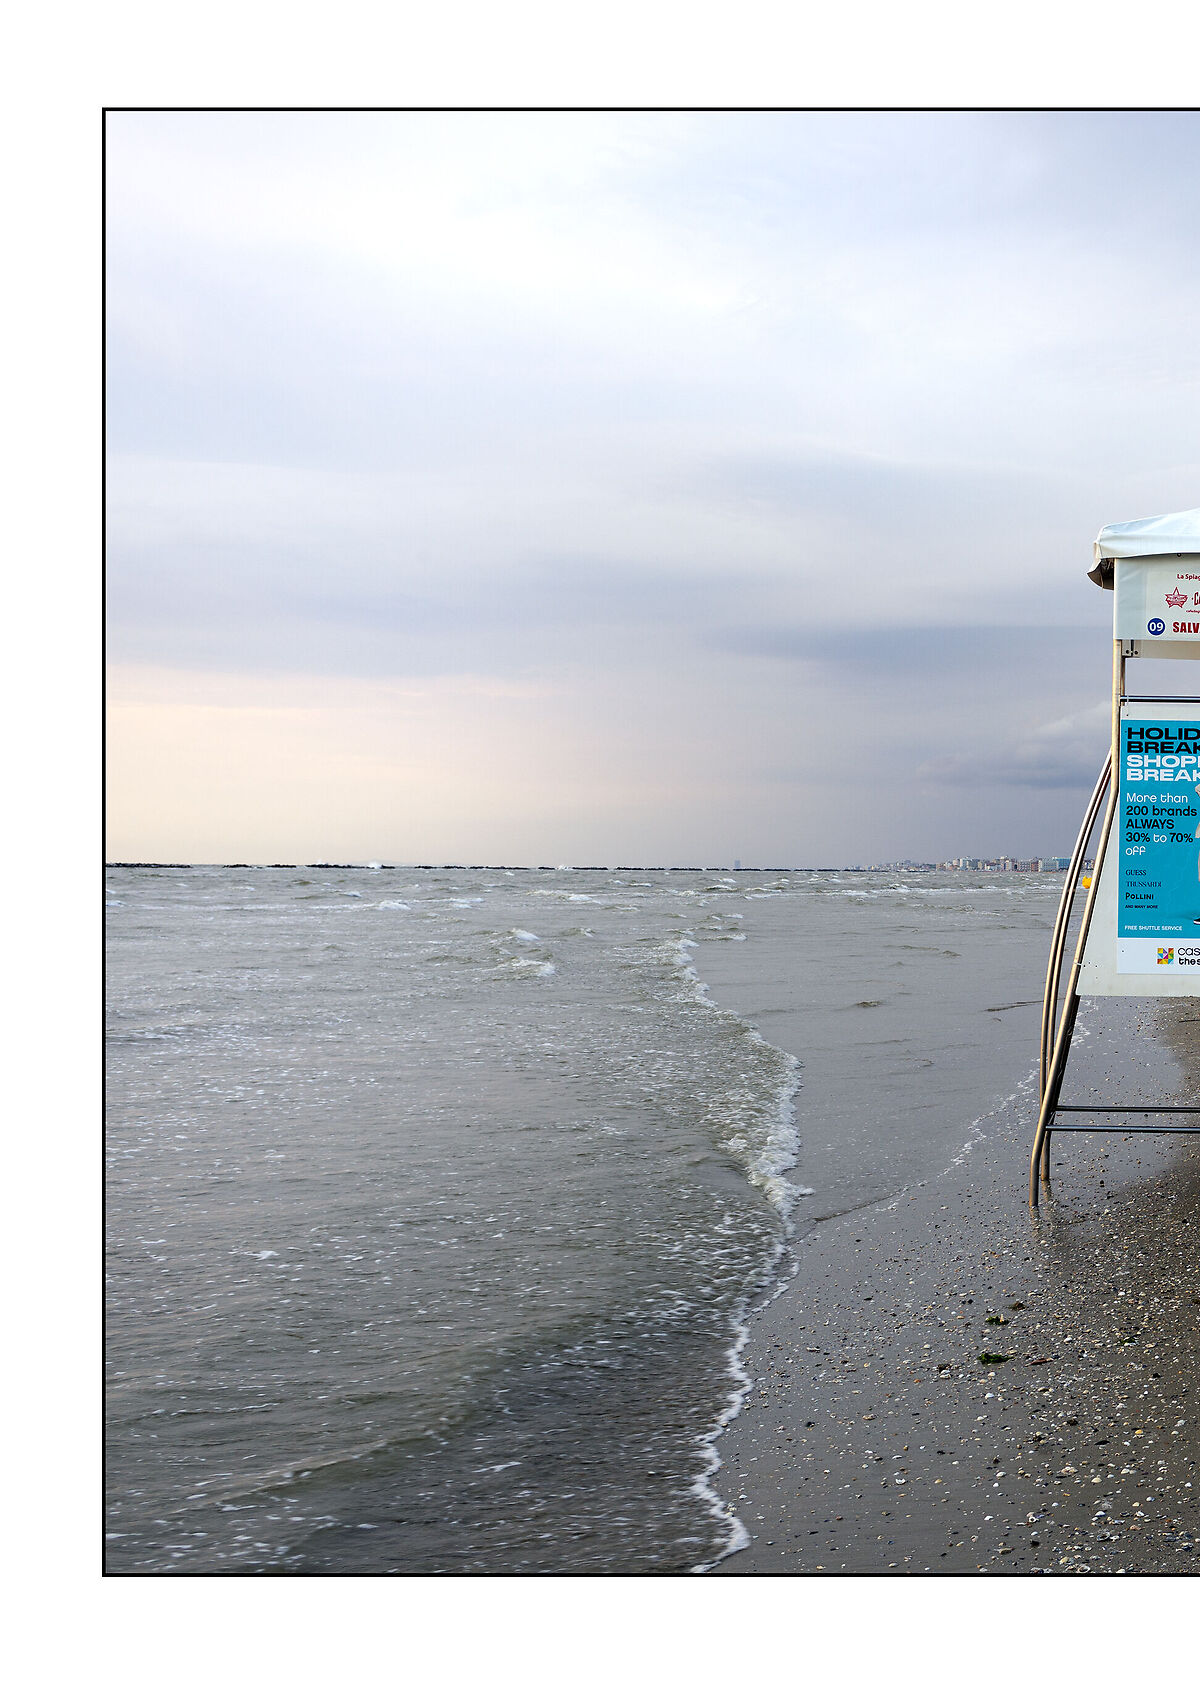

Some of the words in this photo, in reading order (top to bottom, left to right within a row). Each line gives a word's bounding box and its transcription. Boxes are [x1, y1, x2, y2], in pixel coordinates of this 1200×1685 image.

[1149, 622, 1164, 631] 09
[1126, 793, 1157, 803] More
[1160, 793, 1188, 803] than
[1126, 805, 1149, 816] 200
[1152, 805, 1198, 816] brands
[1126, 818, 1175, 829] ALWAYS
[1126, 832, 1151, 842] 30%
[1153, 833, 1167, 843] to
[1169, 832, 1194, 843] 70%
[1125, 846, 1146, 856] off
